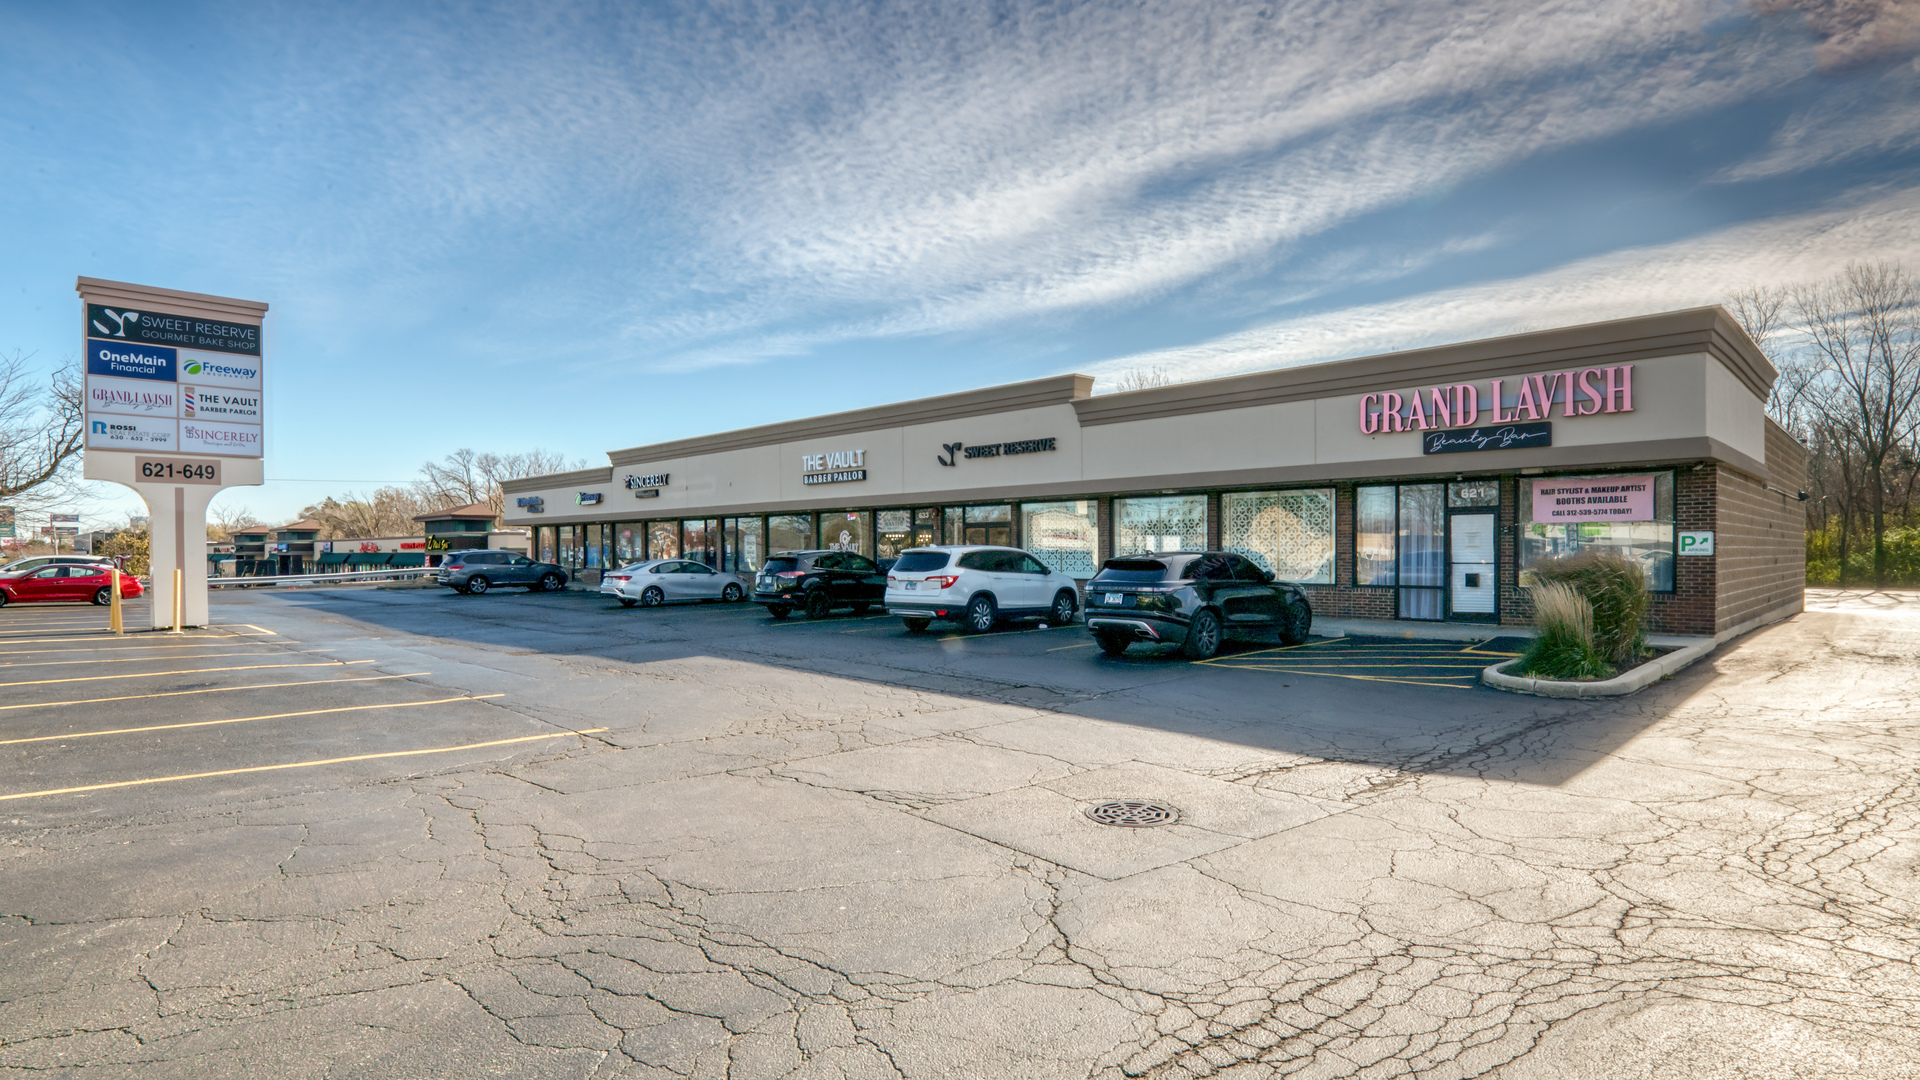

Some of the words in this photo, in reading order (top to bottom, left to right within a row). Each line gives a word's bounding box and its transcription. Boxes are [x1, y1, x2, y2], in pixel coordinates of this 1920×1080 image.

[141, 315, 191, 332] SWEET
[195, 322, 256, 340] RESERVE
[141, 329, 195, 343] GOURMET
[198, 336, 224, 347] BAKE
[227, 340, 256, 350] SHOP
[99, 349, 167, 367] OneMain
[110, 362, 156, 374] Financial
[202, 361, 257, 379] Freeway
[202, 371, 249, 380] INSURANCE
[92, 388, 131, 403] GRAND
[134, 391, 172, 406] LAVISH
[199, 394, 219, 404] THE
[222, 396, 258, 407] VAULT
[1359, 385, 1478, 435] GRAND
[1490, 364, 1635, 424] LAVISH
[200, 406, 228, 414] BARBER
[229, 408, 257, 416] PARLOR
[194, 429, 259, 443] SINCERELY
[1427, 429, 1499, 453] Beauty
[1498, 426, 1548, 448] Bar
[964, 444, 1001, 459] SWEET
[1003, 437, 1056, 455] RESERVE
[802, 454, 825, 472] THE
[826, 449, 865, 470] VAULT
[142, 462, 216, 480] 621-649
[804, 474, 832, 484] BARBER
[833, 471, 864, 481] PARLOR
[630, 473, 669, 489] SINCERELY
[1620, 484, 1647, 492] ARTIST
[1460, 488, 1485, 499] 621
[1556, 497, 1586, 505] BOOTHS
[1587, 495, 1628, 504] AVAILABLE
[918, 511, 929, 519] 633
[1566, 508, 1608, 516] 312-539-5774
[1609, 507, 1633, 515] TODAY!
